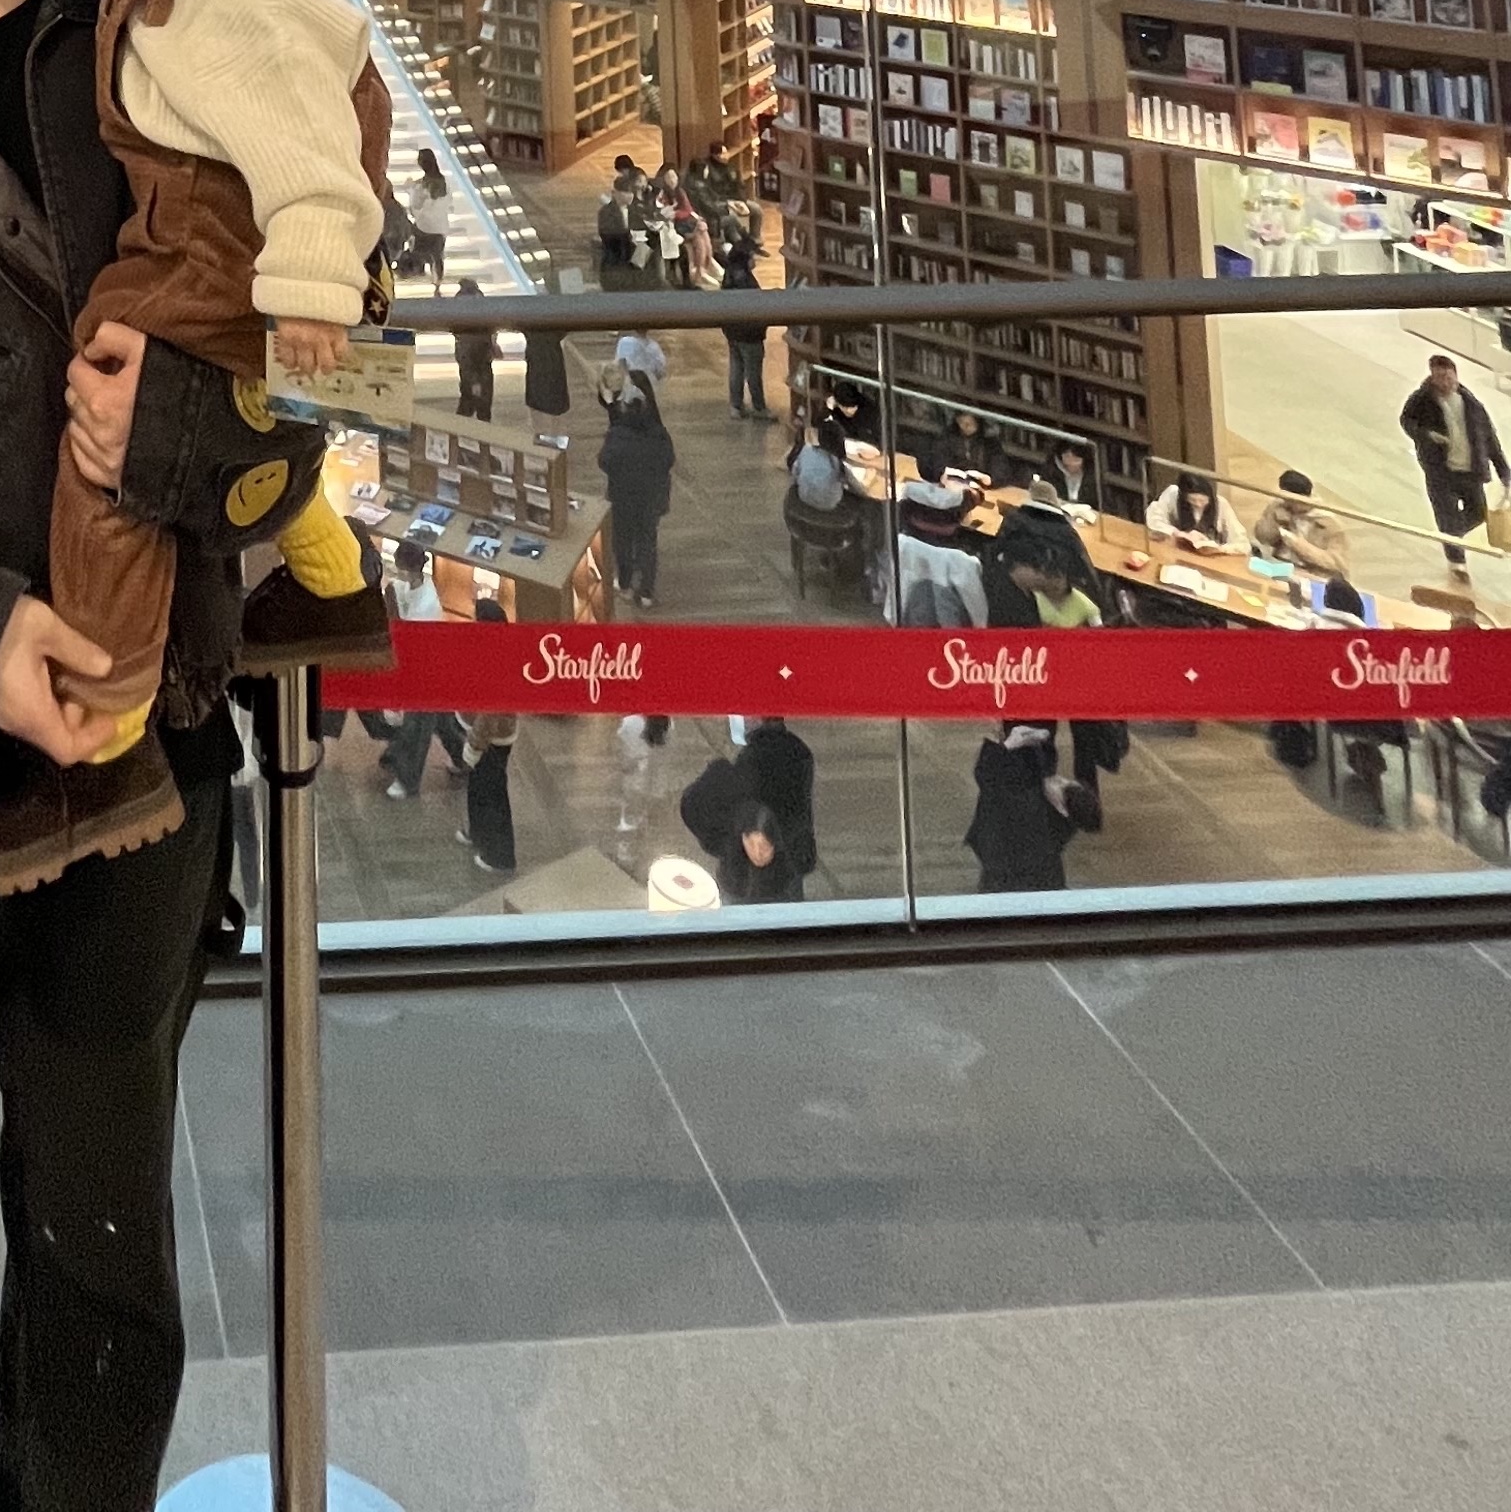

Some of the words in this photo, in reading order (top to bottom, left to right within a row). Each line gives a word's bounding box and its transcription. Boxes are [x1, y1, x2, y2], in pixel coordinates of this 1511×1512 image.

[523, 634, 643, 704] Starfield
[928, 639, 1048, 710] Starfield
[1332, 639, 1450, 709] Starfield
